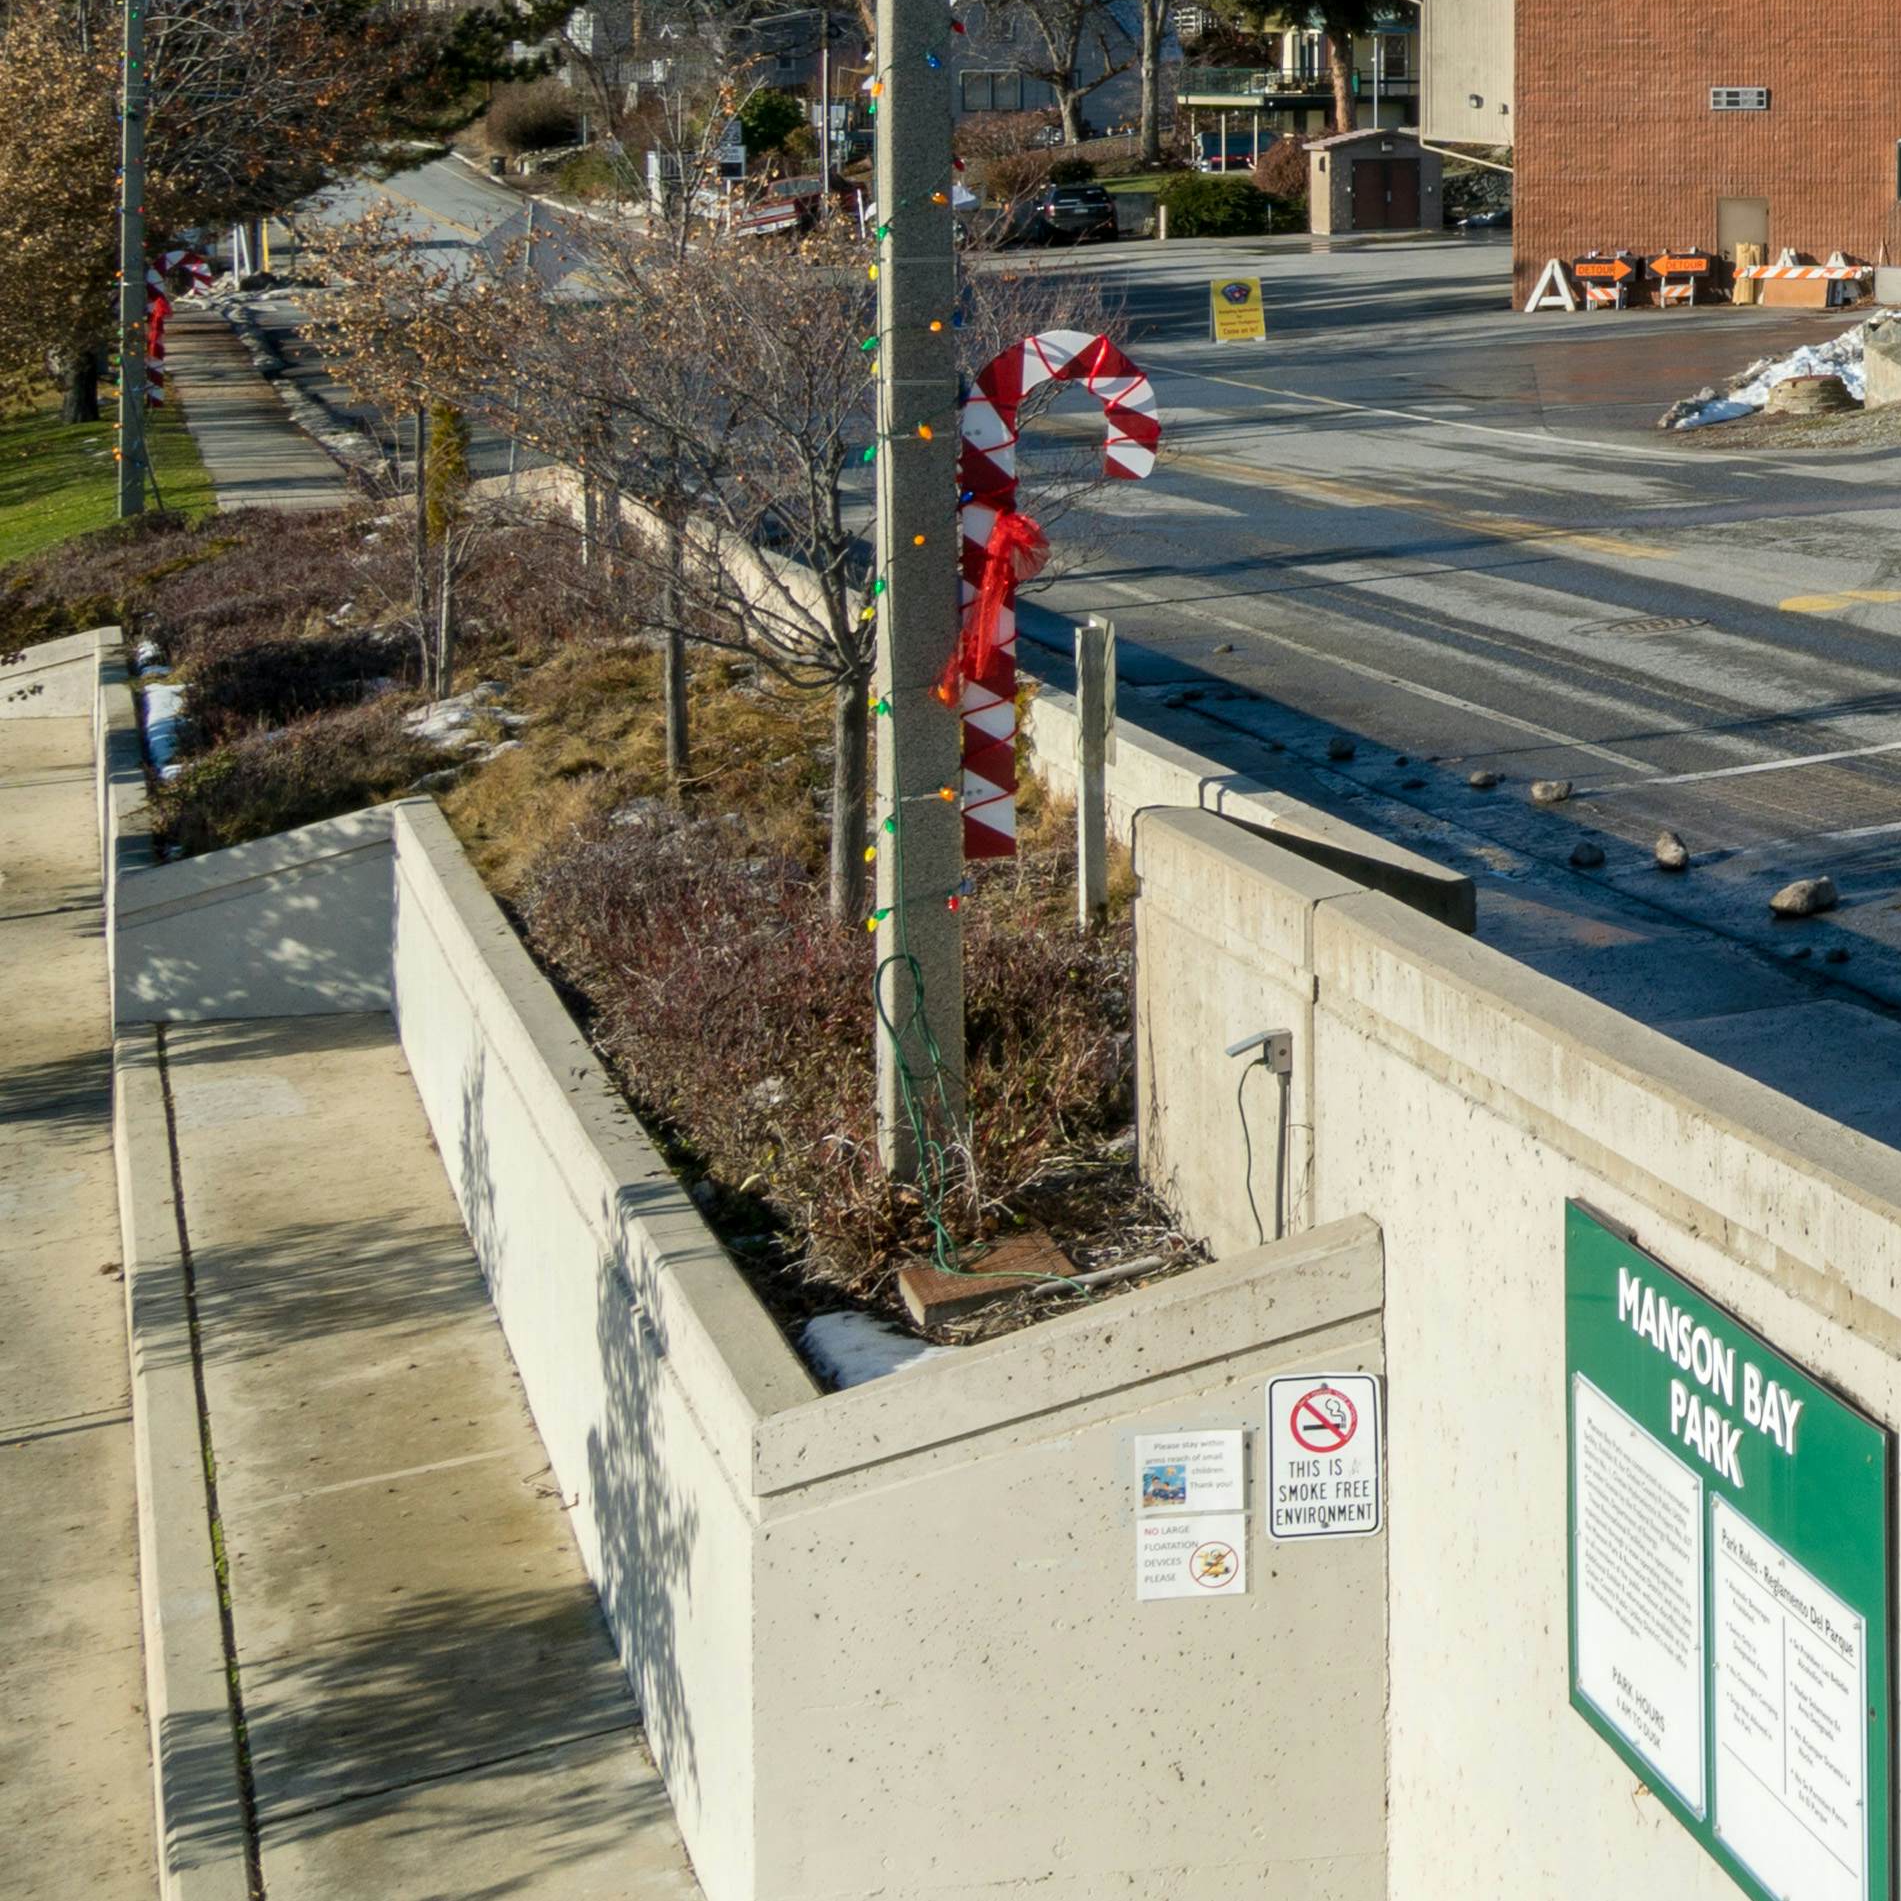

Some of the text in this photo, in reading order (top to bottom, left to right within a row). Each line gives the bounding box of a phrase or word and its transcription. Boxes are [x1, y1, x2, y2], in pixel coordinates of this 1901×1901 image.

[1666, 258, 1704, 270] DETOUR
[1578, 265, 1616, 276] DETOUR
[1618, 1267, 1804, 1455] MANSON BAY
[1671, 1379, 1745, 1489] PARK
[1154, 1440, 1179, 1451] Please
[1182, 1440, 1199, 1451] stay
[1192, 1453, 1201, 1462] of
[1289, 1460, 1320, 1479] THIS
[1329, 1458, 1343, 1477] IS
[1190, 1480, 1215, 1490] Thank
[1279, 1480, 1370, 1503] SMOKE FREE
[1276, 1503, 1373, 1526] ENVIRONMENT
[1144, 1525, 1190, 1537] NO LARGE
[1144, 1540, 1199, 1552] FLOATATION
[1144, 1557, 1182, 1568] DEVICES
[1144, 1573, 1177, 1584] PLEASE
[1722, 1528, 1739, 1557] Park
[1739, 1544, 1758, 1575] Rules
[1810, 1605, 1824, 1632] Del
[1825, 1619, 1855, 1658] Parque
[1611, 1661, 1632, 1700] PARK
[1634, 1685, 1665, 1734] HOURS
